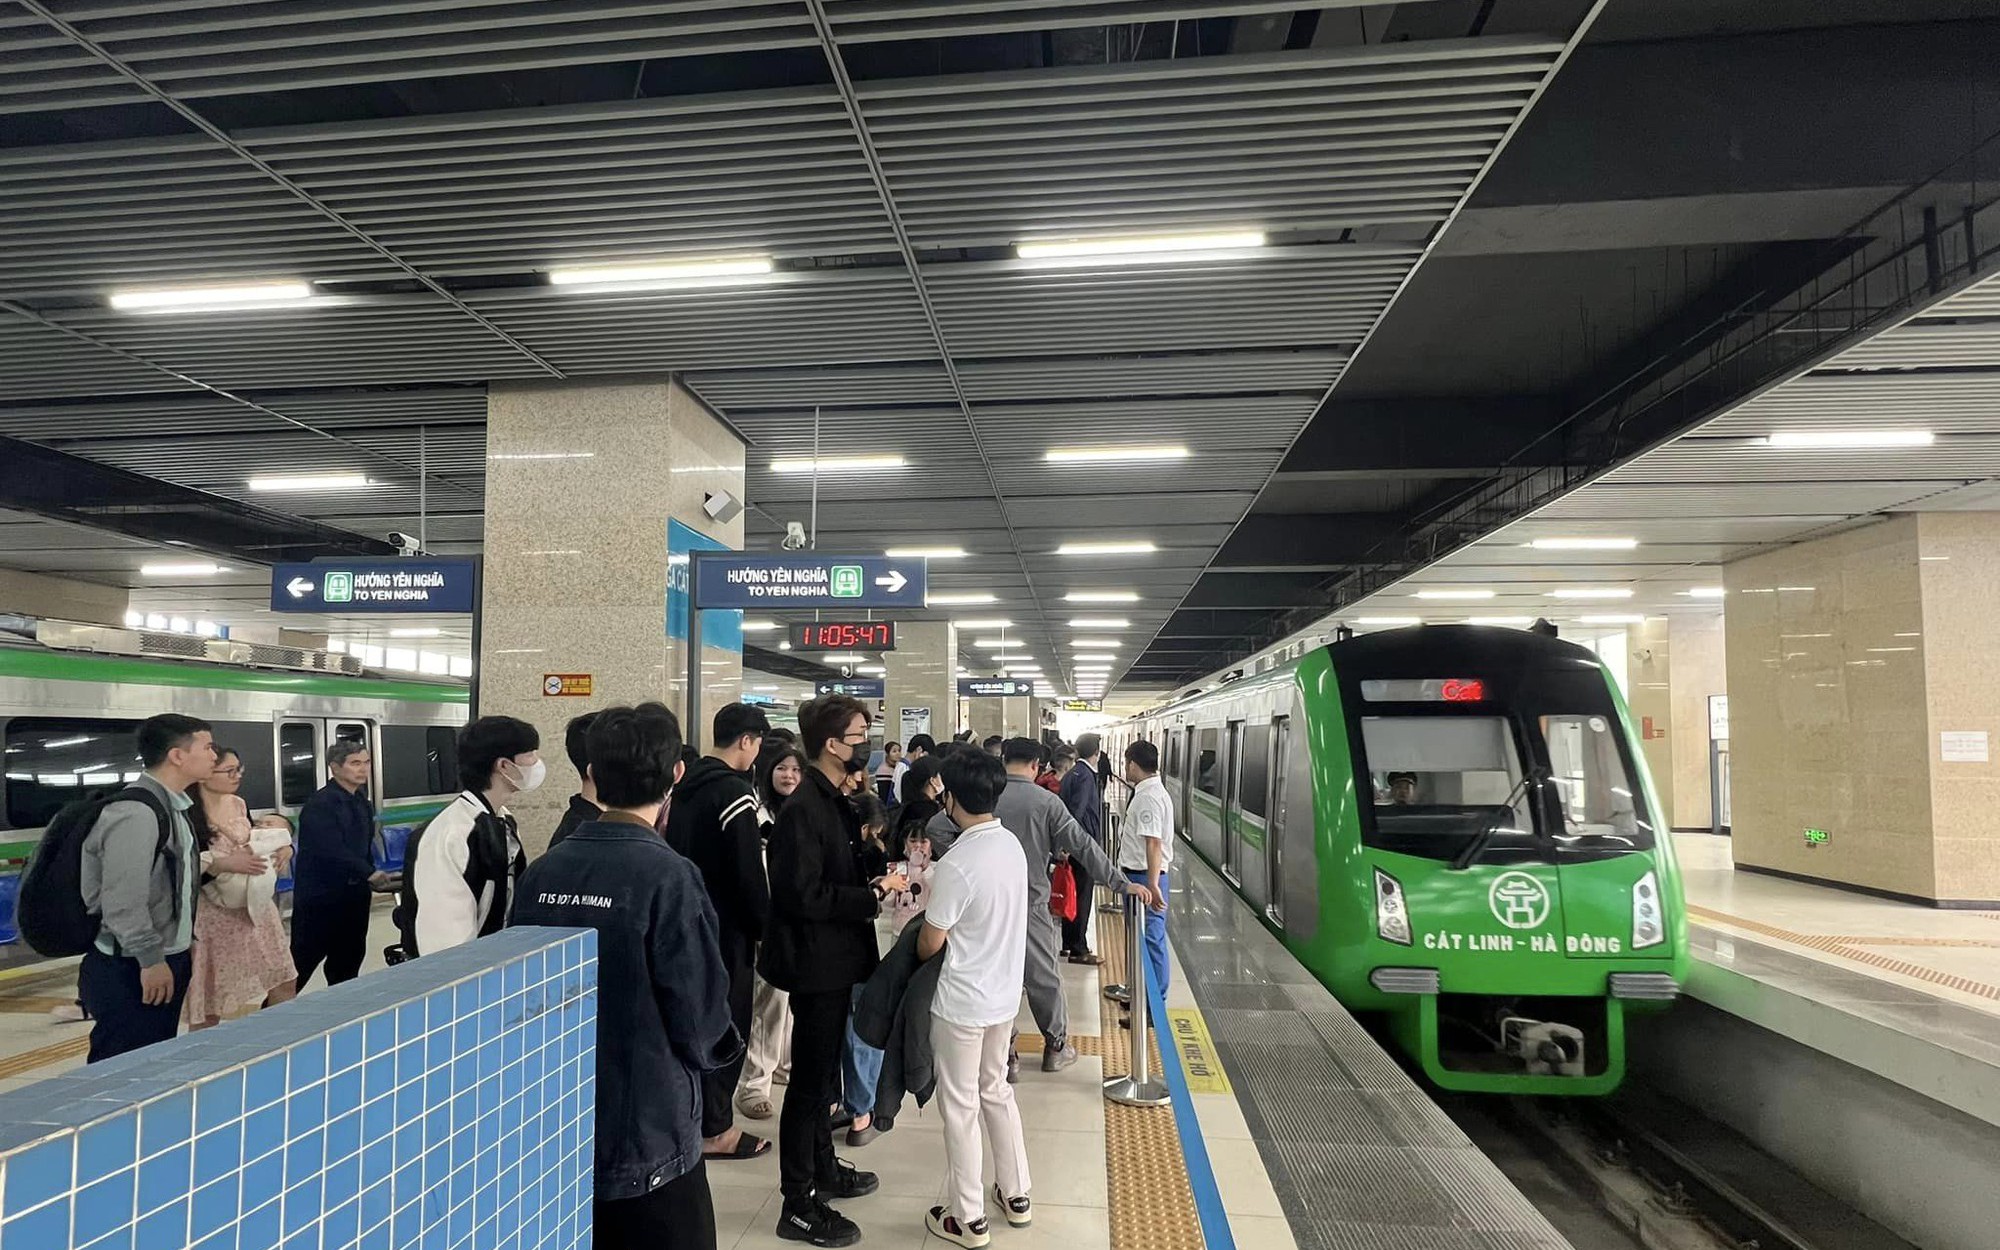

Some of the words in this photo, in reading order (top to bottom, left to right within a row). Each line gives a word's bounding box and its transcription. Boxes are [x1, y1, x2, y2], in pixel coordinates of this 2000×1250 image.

[354, 572, 391, 587] HƯỚNG
[392, 572, 411, 587] YÊN
[413, 572, 445, 587] NGHĨA
[728, 567, 768, 583] HƯỚNG
[770, 567, 791, 583] YÊN
[794, 567, 828, 583] NGHĨA
[354, 590, 369, 600] TO
[371, 590, 392, 600] YEN
[394, 590, 429, 600] NGHIA
[748, 586, 764, 596] TO
[765, 586, 790, 596] YEN
[791, 586, 828, 596] NGHIA
[803, 625, 887, 646] 11:05:47
[538, 893, 547, 903] IT
[547, 893, 557, 904] IS
[571, 894, 580, 905] A
[1424, 930, 1462, 950] CÁT
[1469, 934, 1513, 950] LINH
[1530, 933, 1558, 952] HÀ
[1566, 934, 1621, 953] ĐÔNG
